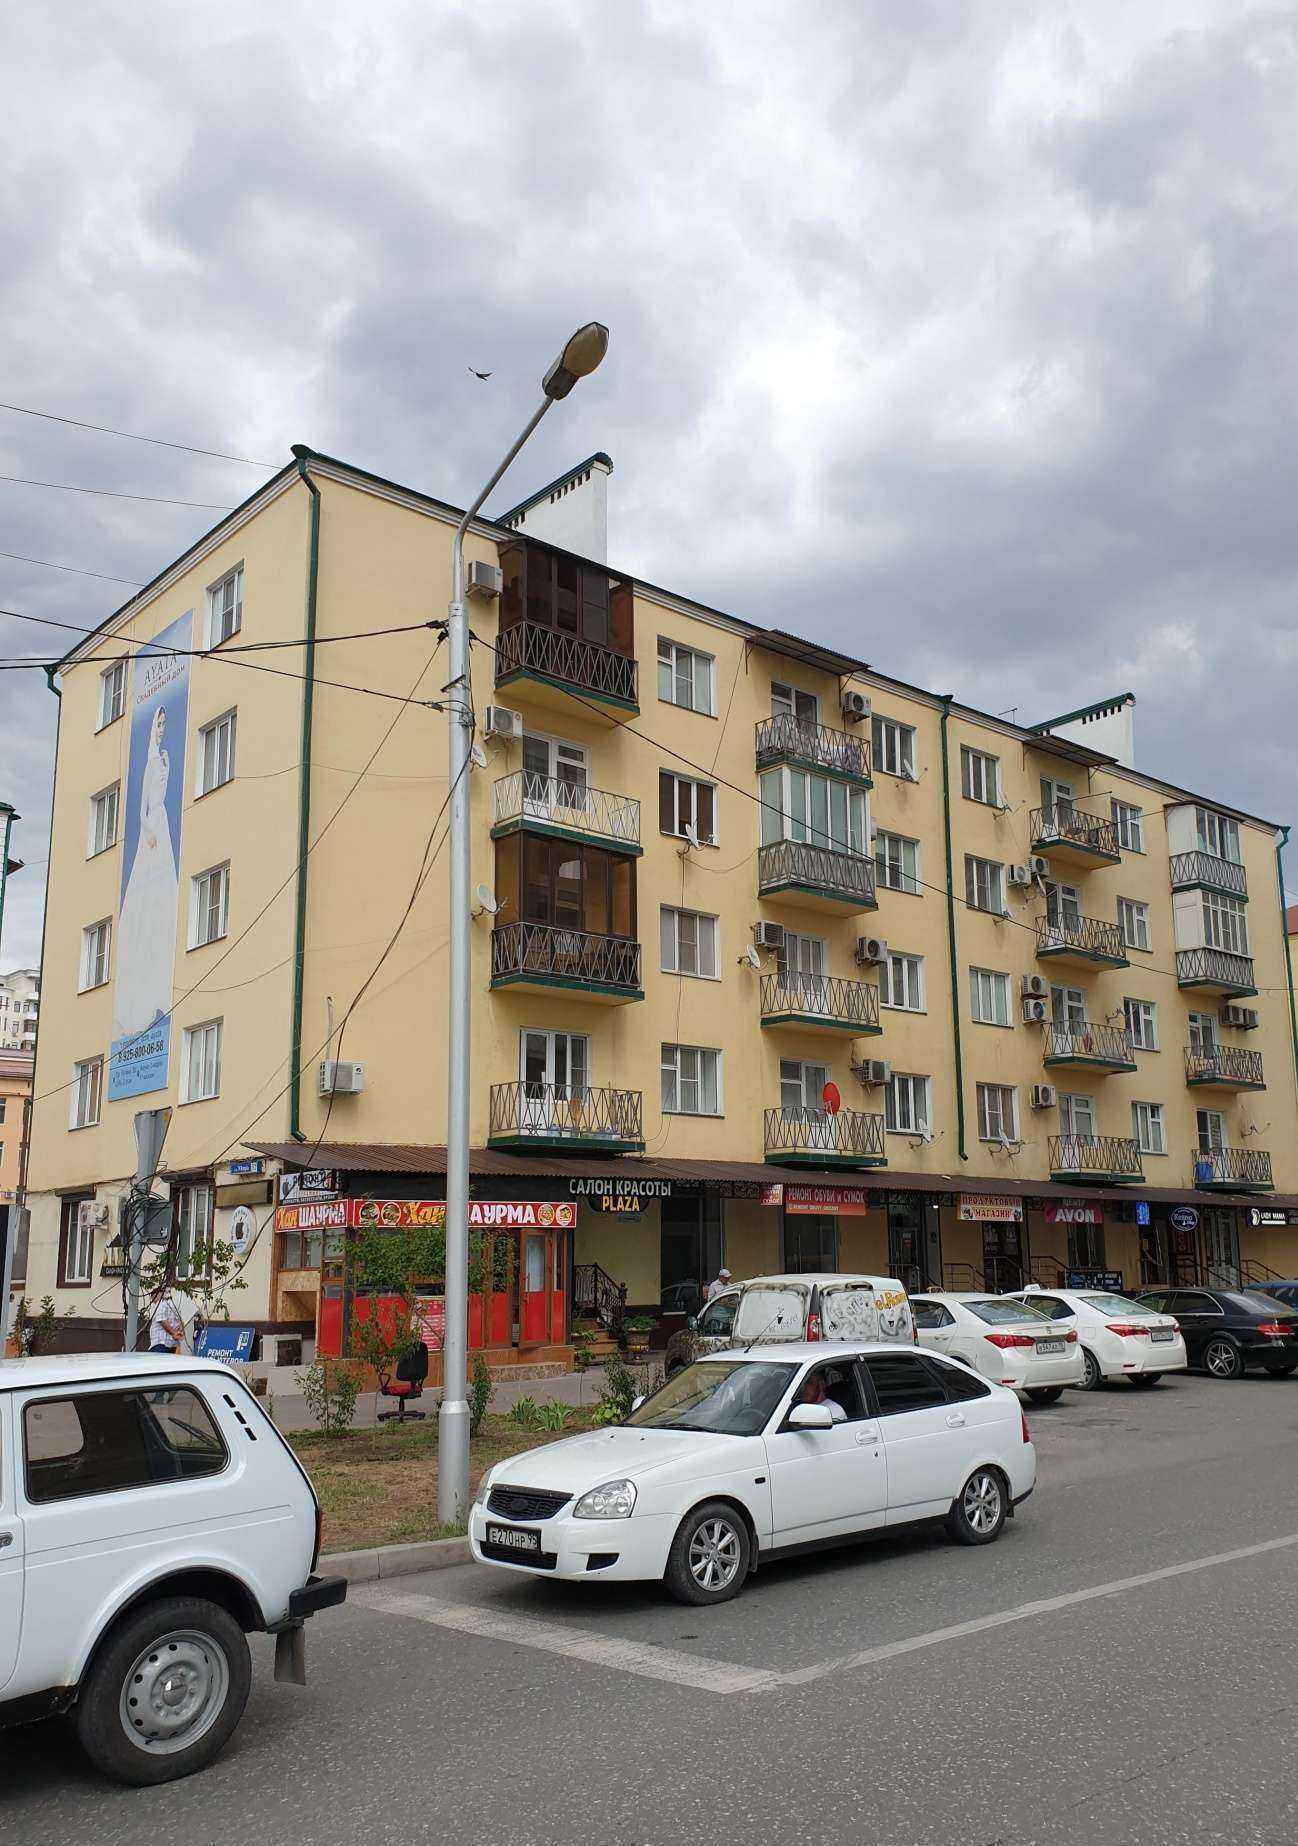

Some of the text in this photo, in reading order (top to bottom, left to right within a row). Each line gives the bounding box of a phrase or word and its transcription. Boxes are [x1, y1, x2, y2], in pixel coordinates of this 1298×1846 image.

[569, 1179, 671, 1196] САЛОН КРАСОТЫ
[602, 1195, 640, 1211] PLAZA
[299, 1203, 345, 1226] ШАУРМА
[467, 1204, 536, 1224] АУРМА
[1055, 1208, 1095, 1223] AVON
[207, 1348, 234, 1357] РЕМОНТ
